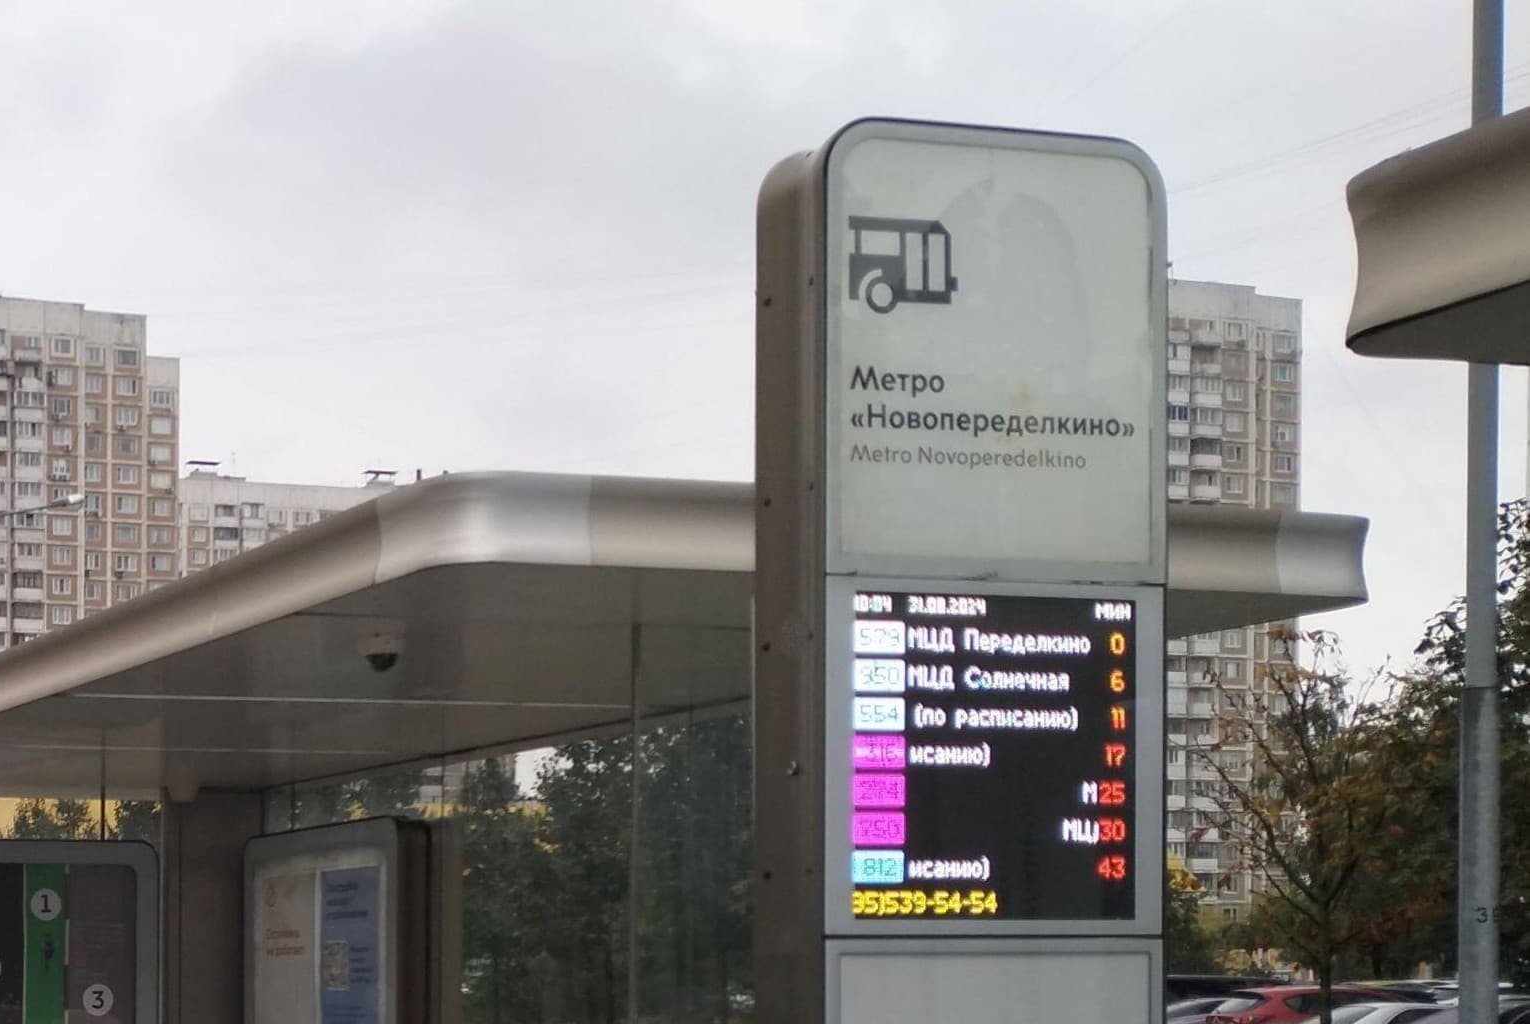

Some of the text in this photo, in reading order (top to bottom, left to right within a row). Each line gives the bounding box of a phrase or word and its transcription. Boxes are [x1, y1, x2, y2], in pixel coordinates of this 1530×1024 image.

[850, 365, 945, 397] Метро
[851, 403, 1135, 437] «Новопеределкино»
[850, 445, 1087, 469] Metro Novoperedelkino
[907, 626, 956, 652] МЦД
[963, 627, 1092, 655] Переделкино
[1109, 632, 1125, 655] 0
[907, 664, 956, 690] МЦД
[964, 665, 1070, 692] Солнечная
[1109, 669, 1125, 692] 6
[860, 703, 1126, 731] 554 (по расписанию) 11
[909, 741, 991, 768] исанию)
[1105, 743, 1126, 767] 17
[1082, 780, 1098, 805] М
[1098, 781, 1126, 804] 25
[1100, 819, 1126, 842] 30
[863, 855, 1126, 882] 812 исанию) 43
[40, 894, 52, 913] 1
[91, 990, 104, 1009] 3
